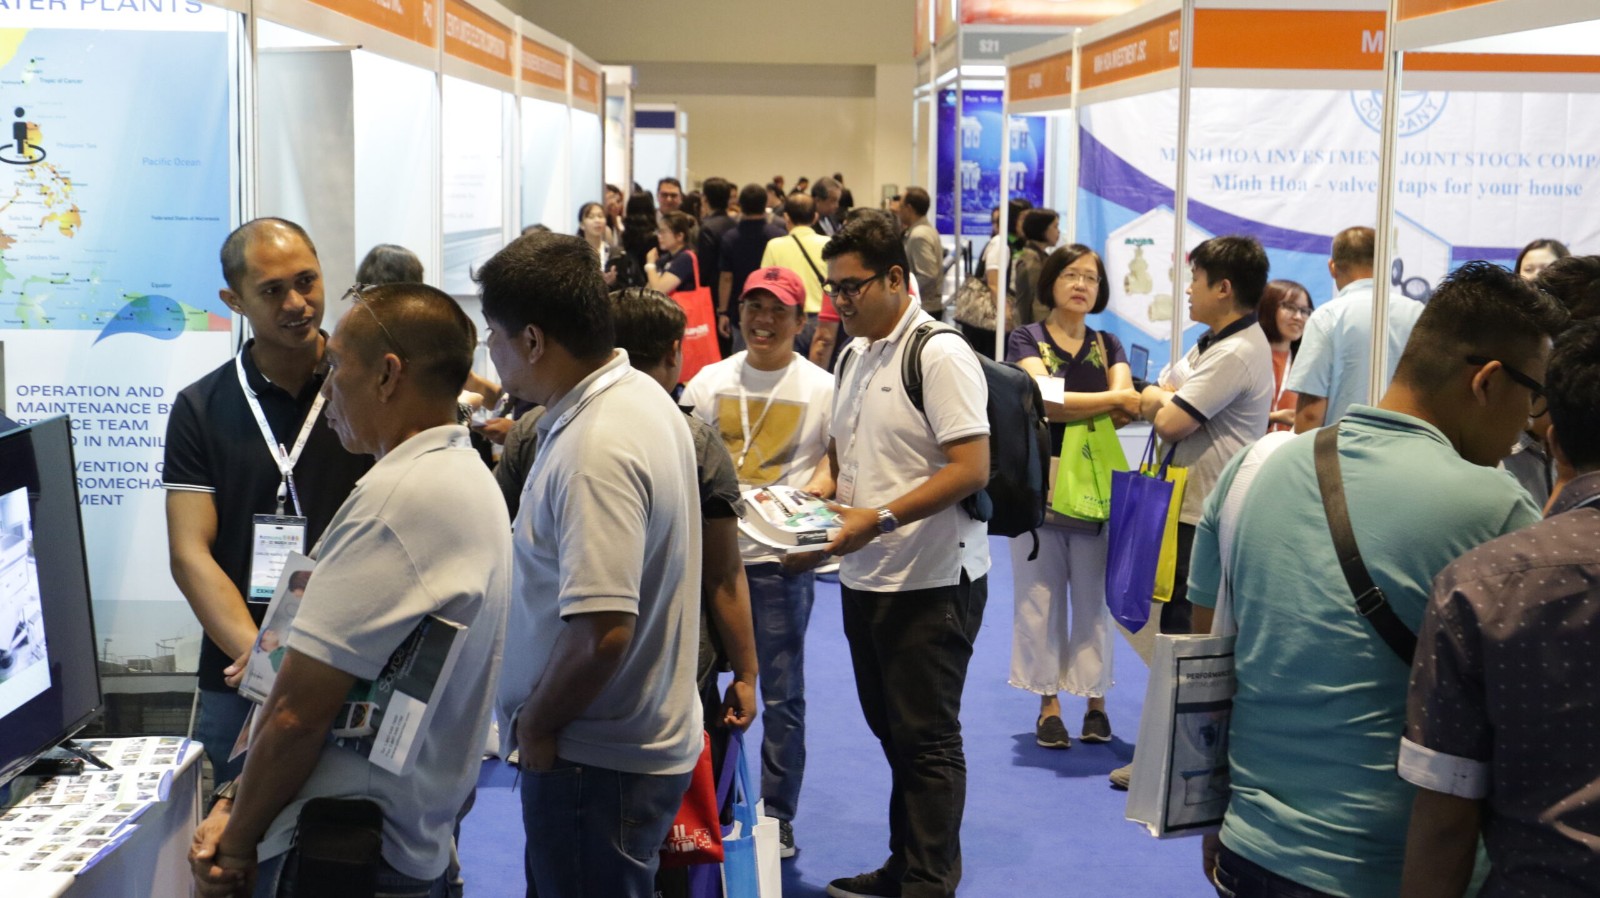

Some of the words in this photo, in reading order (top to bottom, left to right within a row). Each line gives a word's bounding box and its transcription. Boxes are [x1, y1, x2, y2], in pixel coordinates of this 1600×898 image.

[1360, 98, 1438, 130] COPANY
[142, 157, 172, 167] Pacific
[174, 157, 202, 167] Ocean
[1161, 147, 1212, 162] MNH
[1220, 148, 1262, 163] HOA
[1267, 149, 1380, 165] INVESTMEN
[1400, 151, 1461, 166] JOINT
[1465, 152, 1531, 168] STOCK
[1212, 174, 1262, 191] Minh
[1270, 175, 1307, 191] Hoa
[1398, 178, 1437, 198] taps
[1445, 177, 1472, 193] for
[1477, 182, 1523, 200] your
[1529, 179, 1583, 196] house
[16, 385, 120, 397] OPERATION
[125, 386, 164, 398] AND
[17, 402, 151, 414] MAINTENANCE
[97, 419, 149, 431] TEAM
[84, 436, 102, 447] IN
[108, 436, 166, 448] MANIL
[77, 477, 164, 489] ROMECHA
[379, 648, 405, 692] Source
